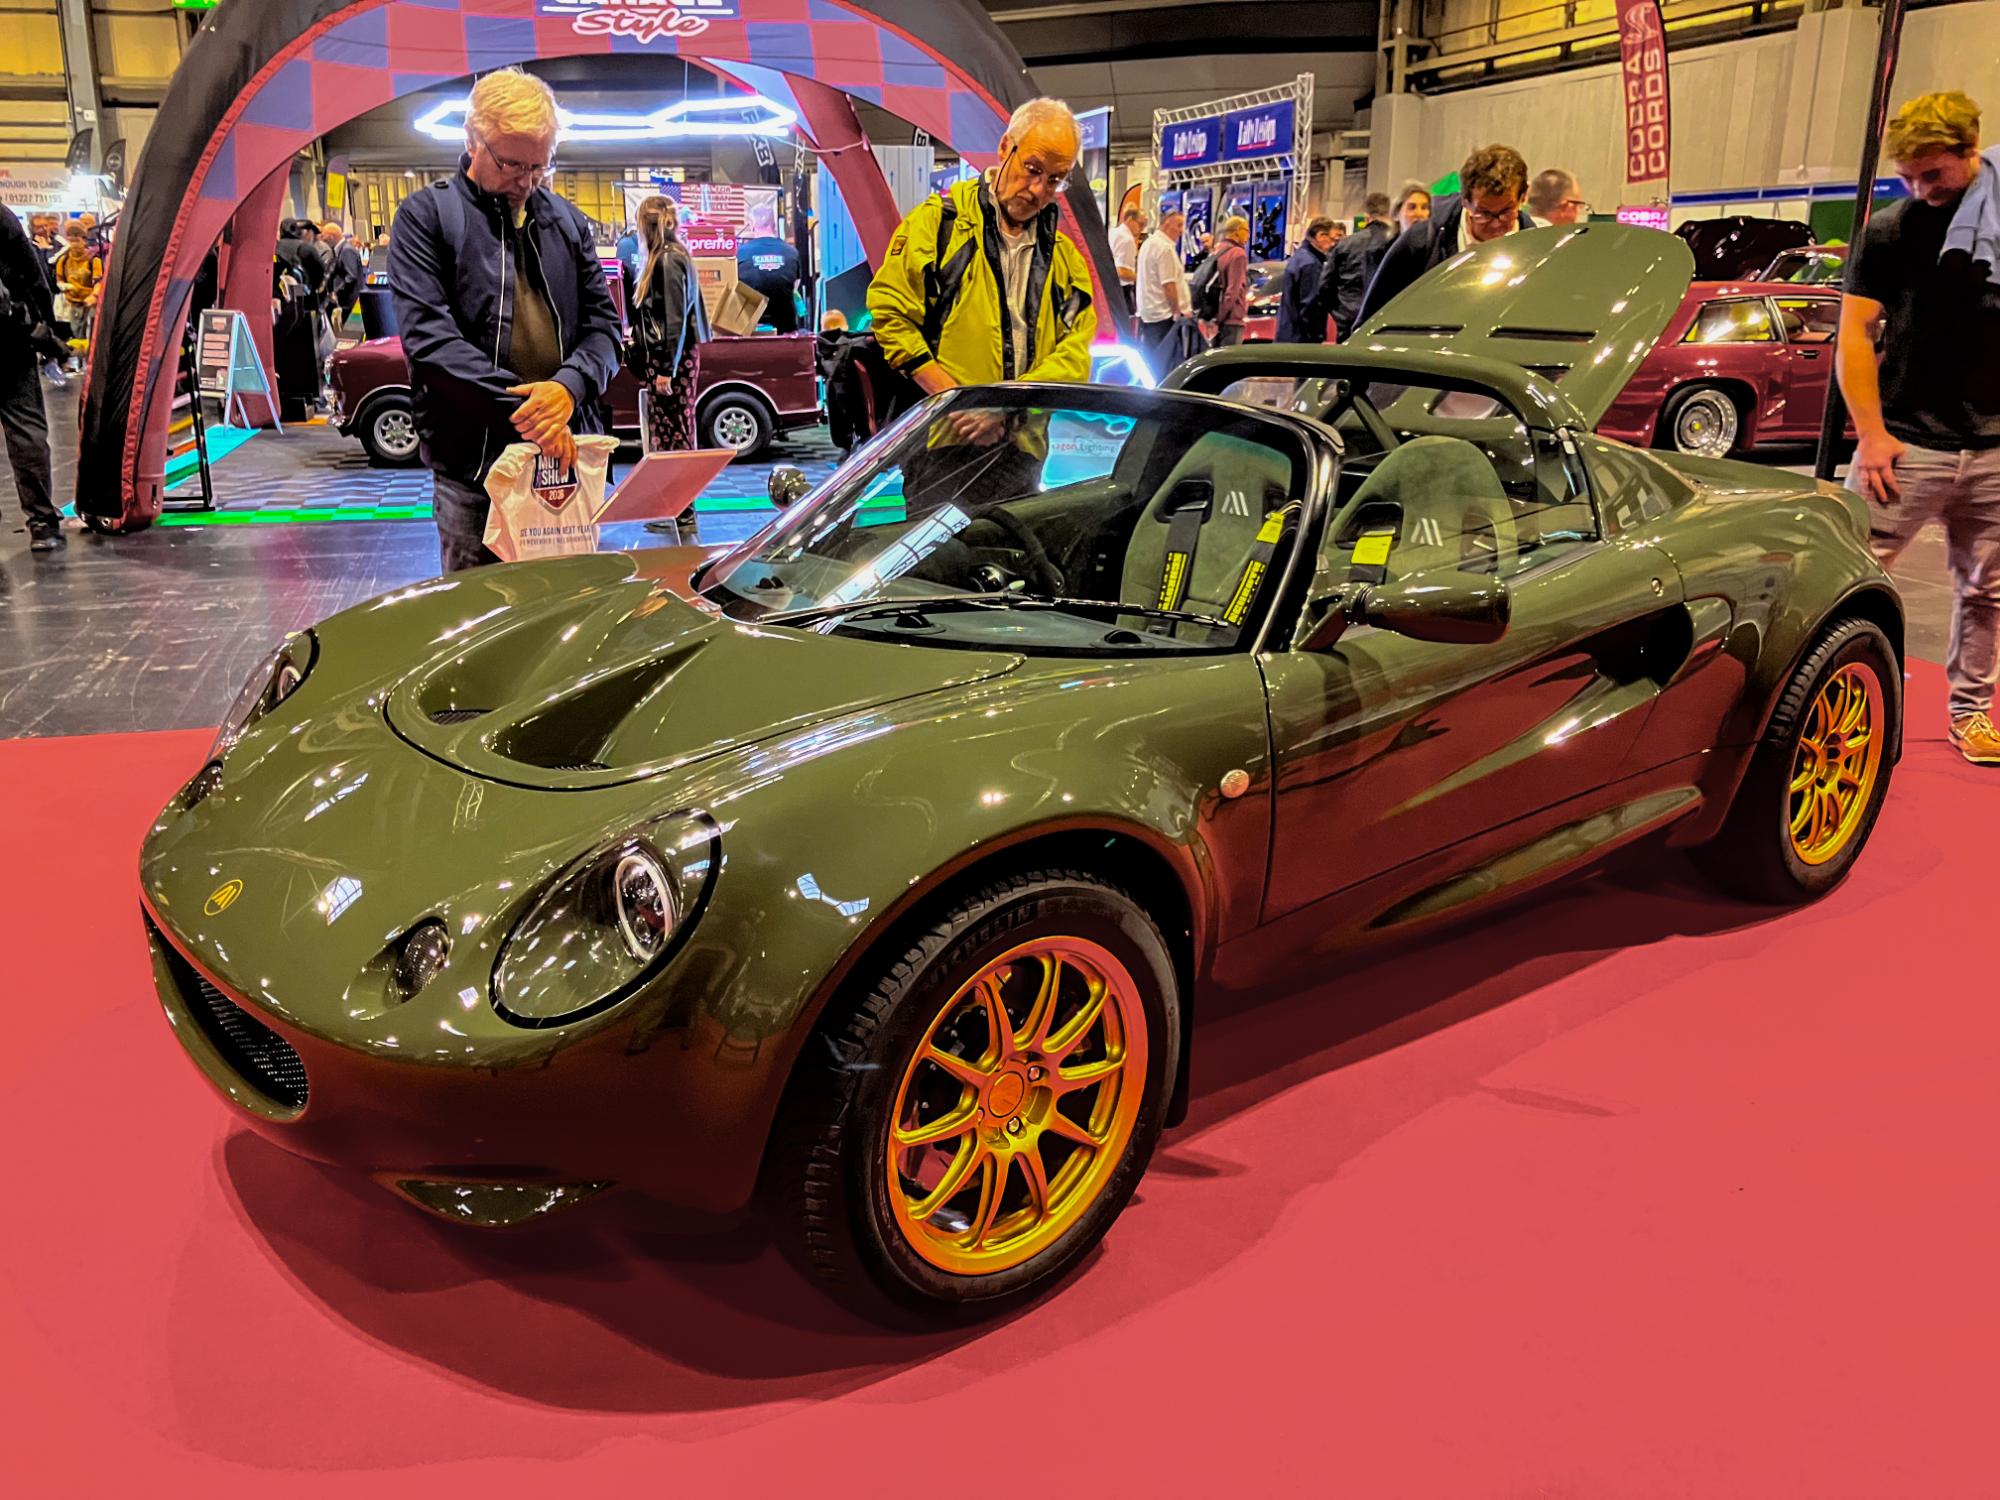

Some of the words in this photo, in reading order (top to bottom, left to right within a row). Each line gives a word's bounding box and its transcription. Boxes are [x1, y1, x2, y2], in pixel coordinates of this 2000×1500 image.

[573, 9, 708, 43] Style
[1626, 52, 1646, 177] COBRA
[1644, 48, 1665, 174] CORDS
[0, 180, 27, 189] NOUGH
[529, 527, 541, 537] YOU
[542, 526, 561, 536] AGAIN
